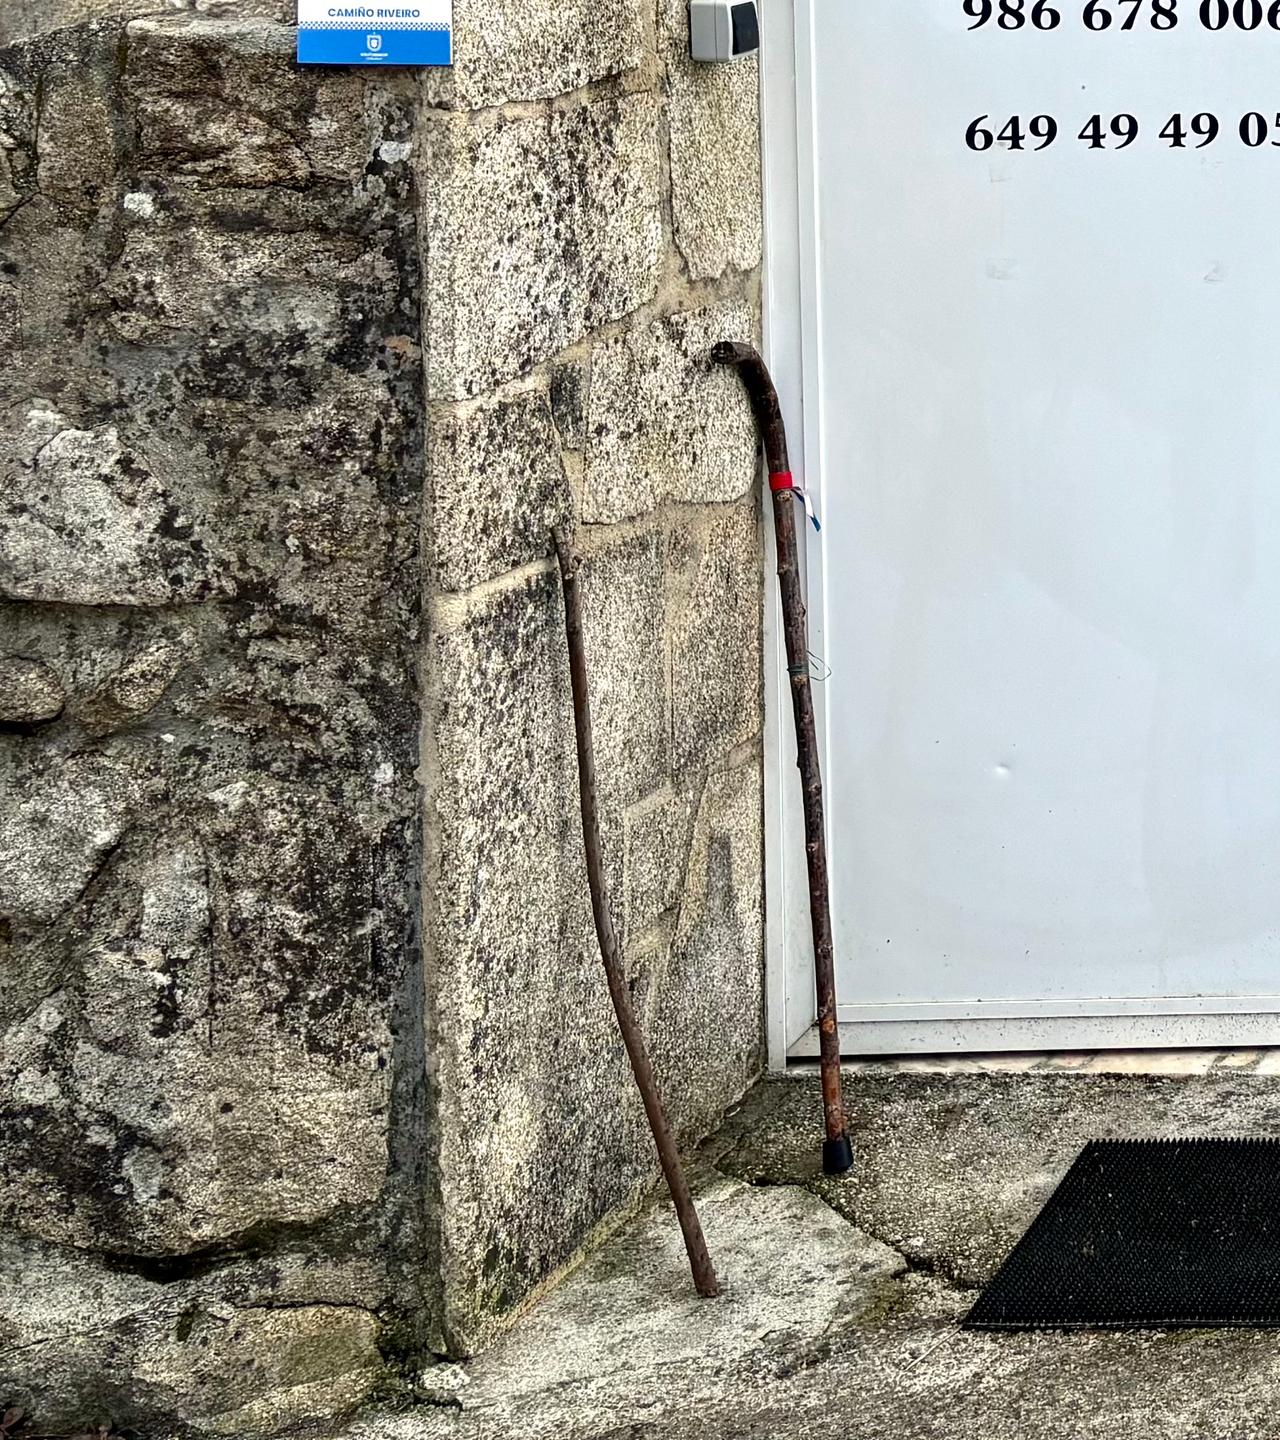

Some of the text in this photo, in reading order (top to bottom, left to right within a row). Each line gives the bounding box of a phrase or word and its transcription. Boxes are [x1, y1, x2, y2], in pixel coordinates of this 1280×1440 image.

[328, 6, 420, 18] CAMIÑO RIVEIRO
[966, 115, 1057, 151] 649
[1078, 114, 1138, 149] 49
[1159, 113, 1218, 148] 49
